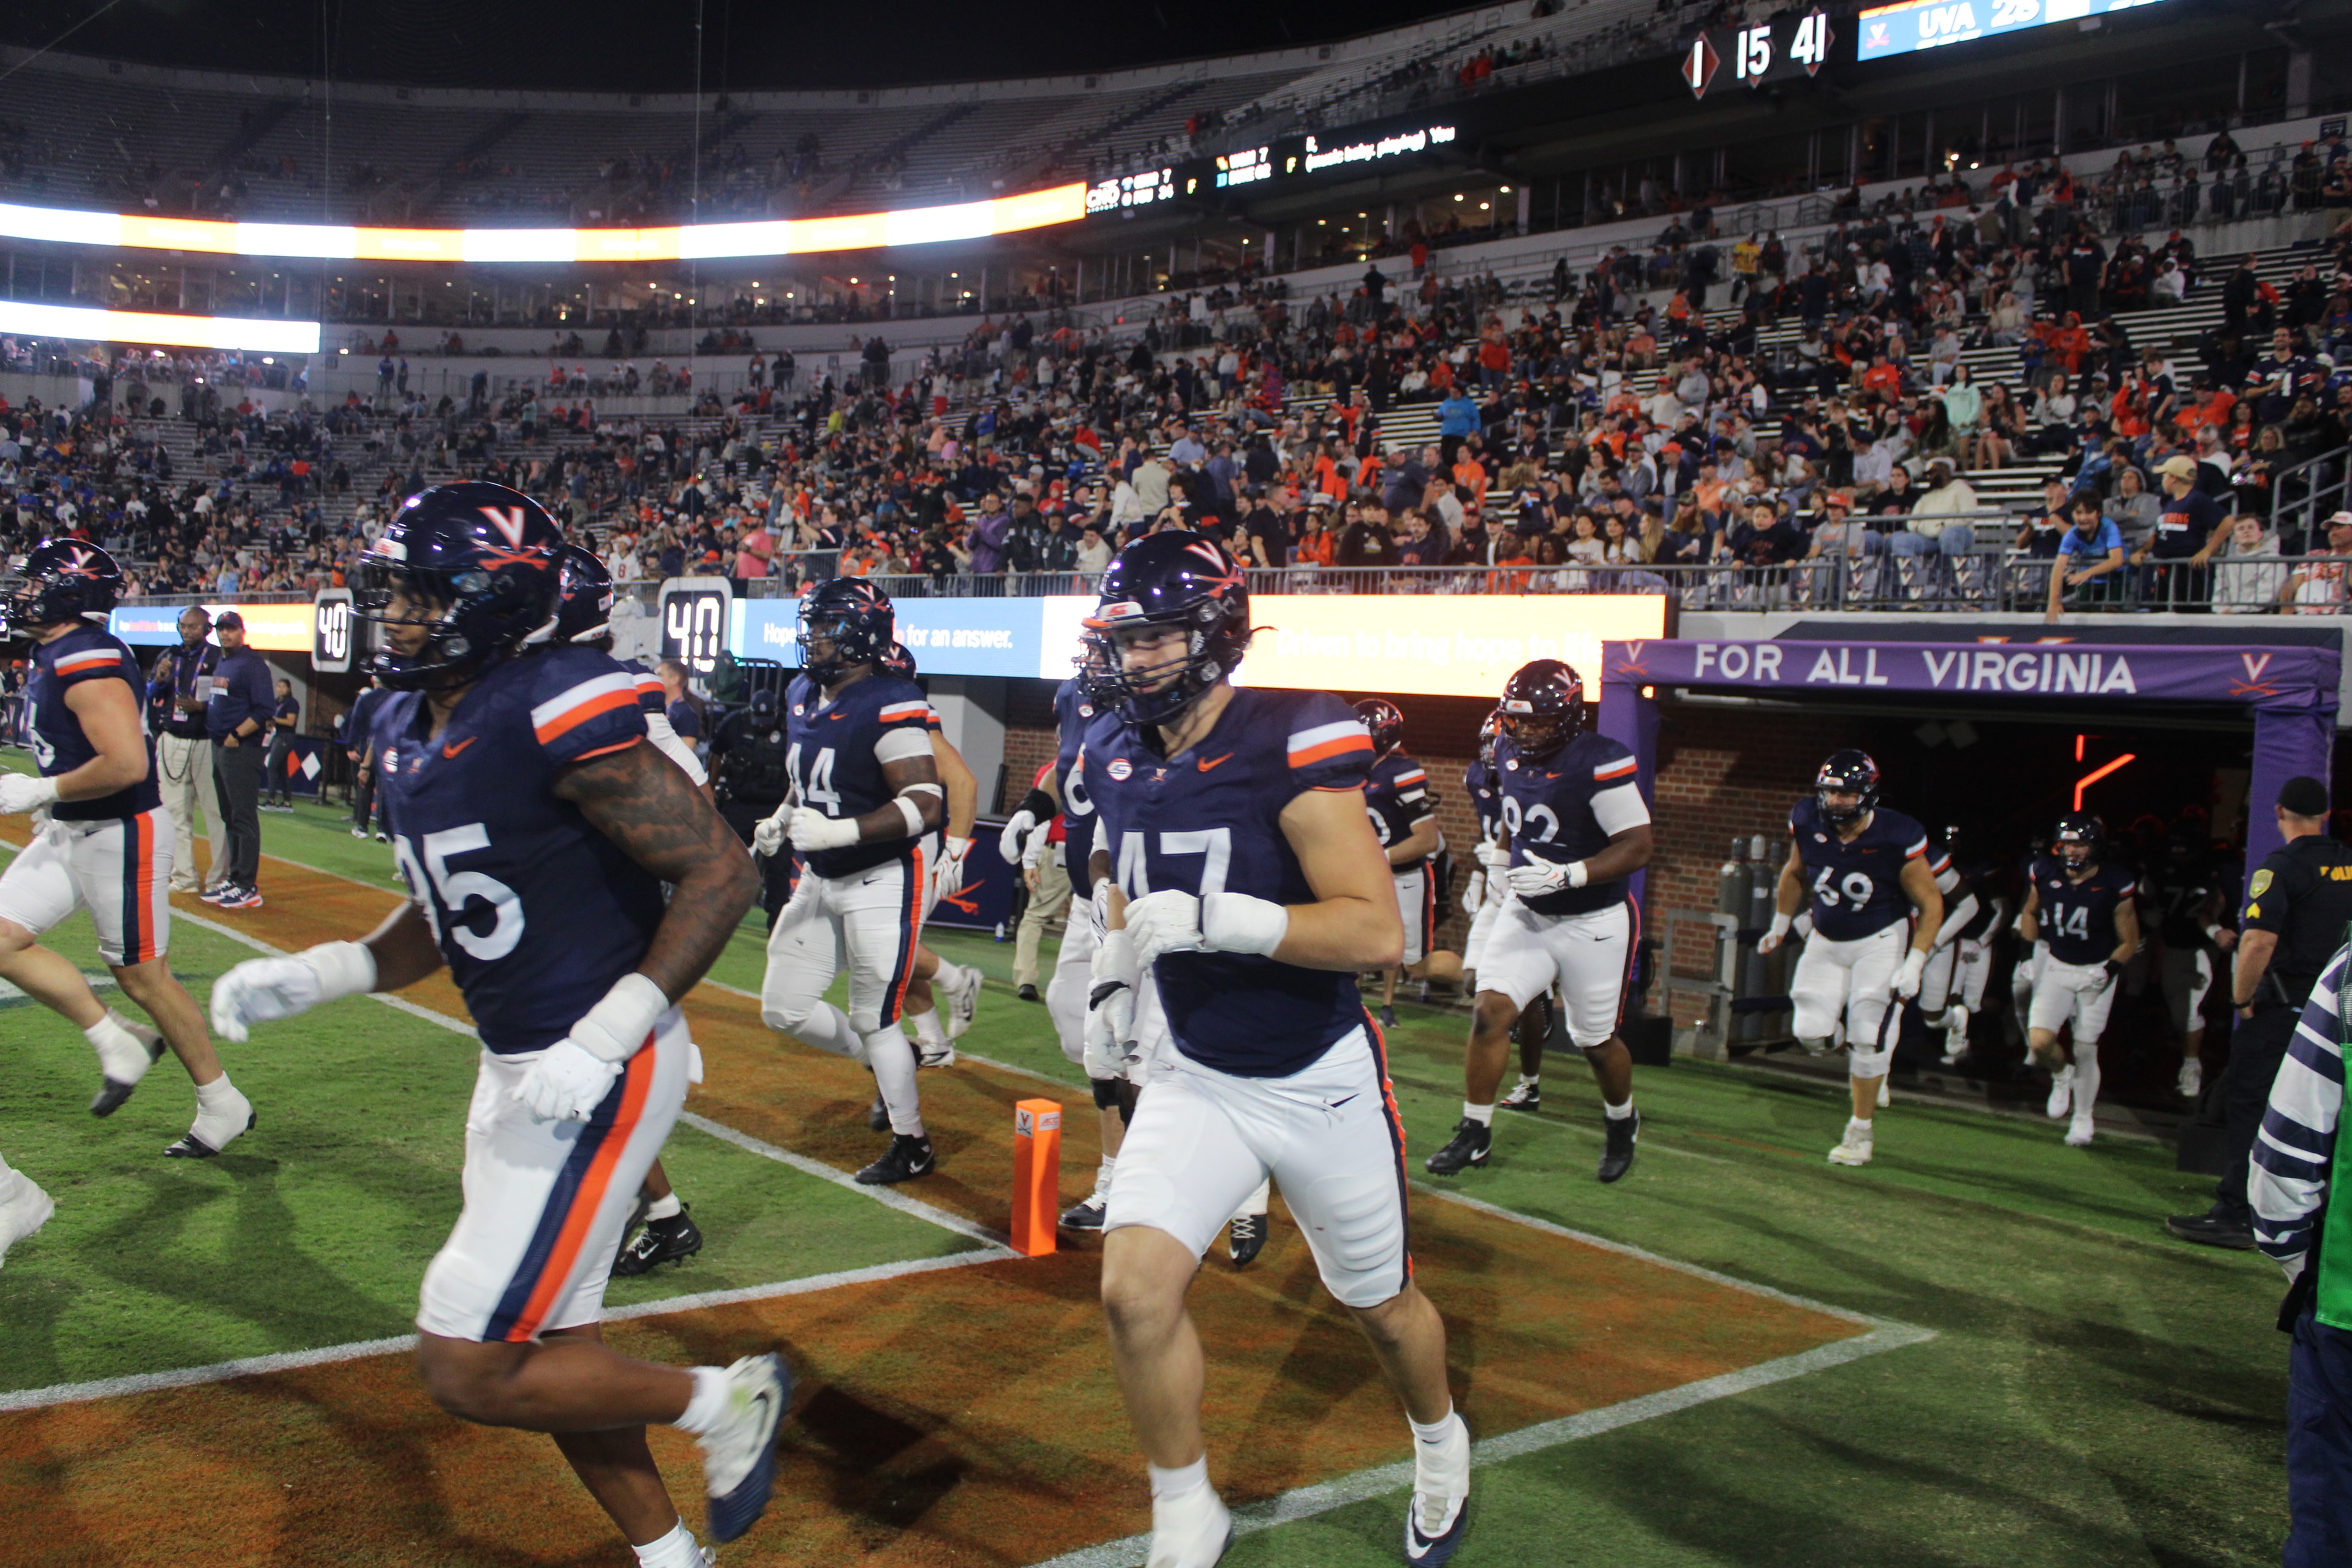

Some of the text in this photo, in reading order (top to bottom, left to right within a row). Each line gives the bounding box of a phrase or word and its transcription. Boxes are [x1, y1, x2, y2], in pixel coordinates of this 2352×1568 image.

[1790, 13, 1826, 65] 41
[1919, 4, 1977, 38] UVA
[1692, 40, 1703, 88] 1
[1736, 25, 1771, 79] 15
[318, 603, 347, 658] 40
[668, 597, 720, 673] 40
[764, 623, 797, 647] Hope
[907, 624, 929, 647] for
[930, 629, 949, 647] an
[952, 630, 1012, 649] answer.
[1276, 628, 1350, 658] Driven
[1356, 630, 1379, 658] to
[1385, 630, 1450, 666] bring
[1455, 631, 1523, 667] hope
[1528, 632, 1558, 660] to
[1694, 644, 2138, 695] FOR ALL VIRGINIA
[786, 742, 842, 816] 44
[1814, 865, 1874, 911] 69
[2054, 902, 2089, 940] 14
